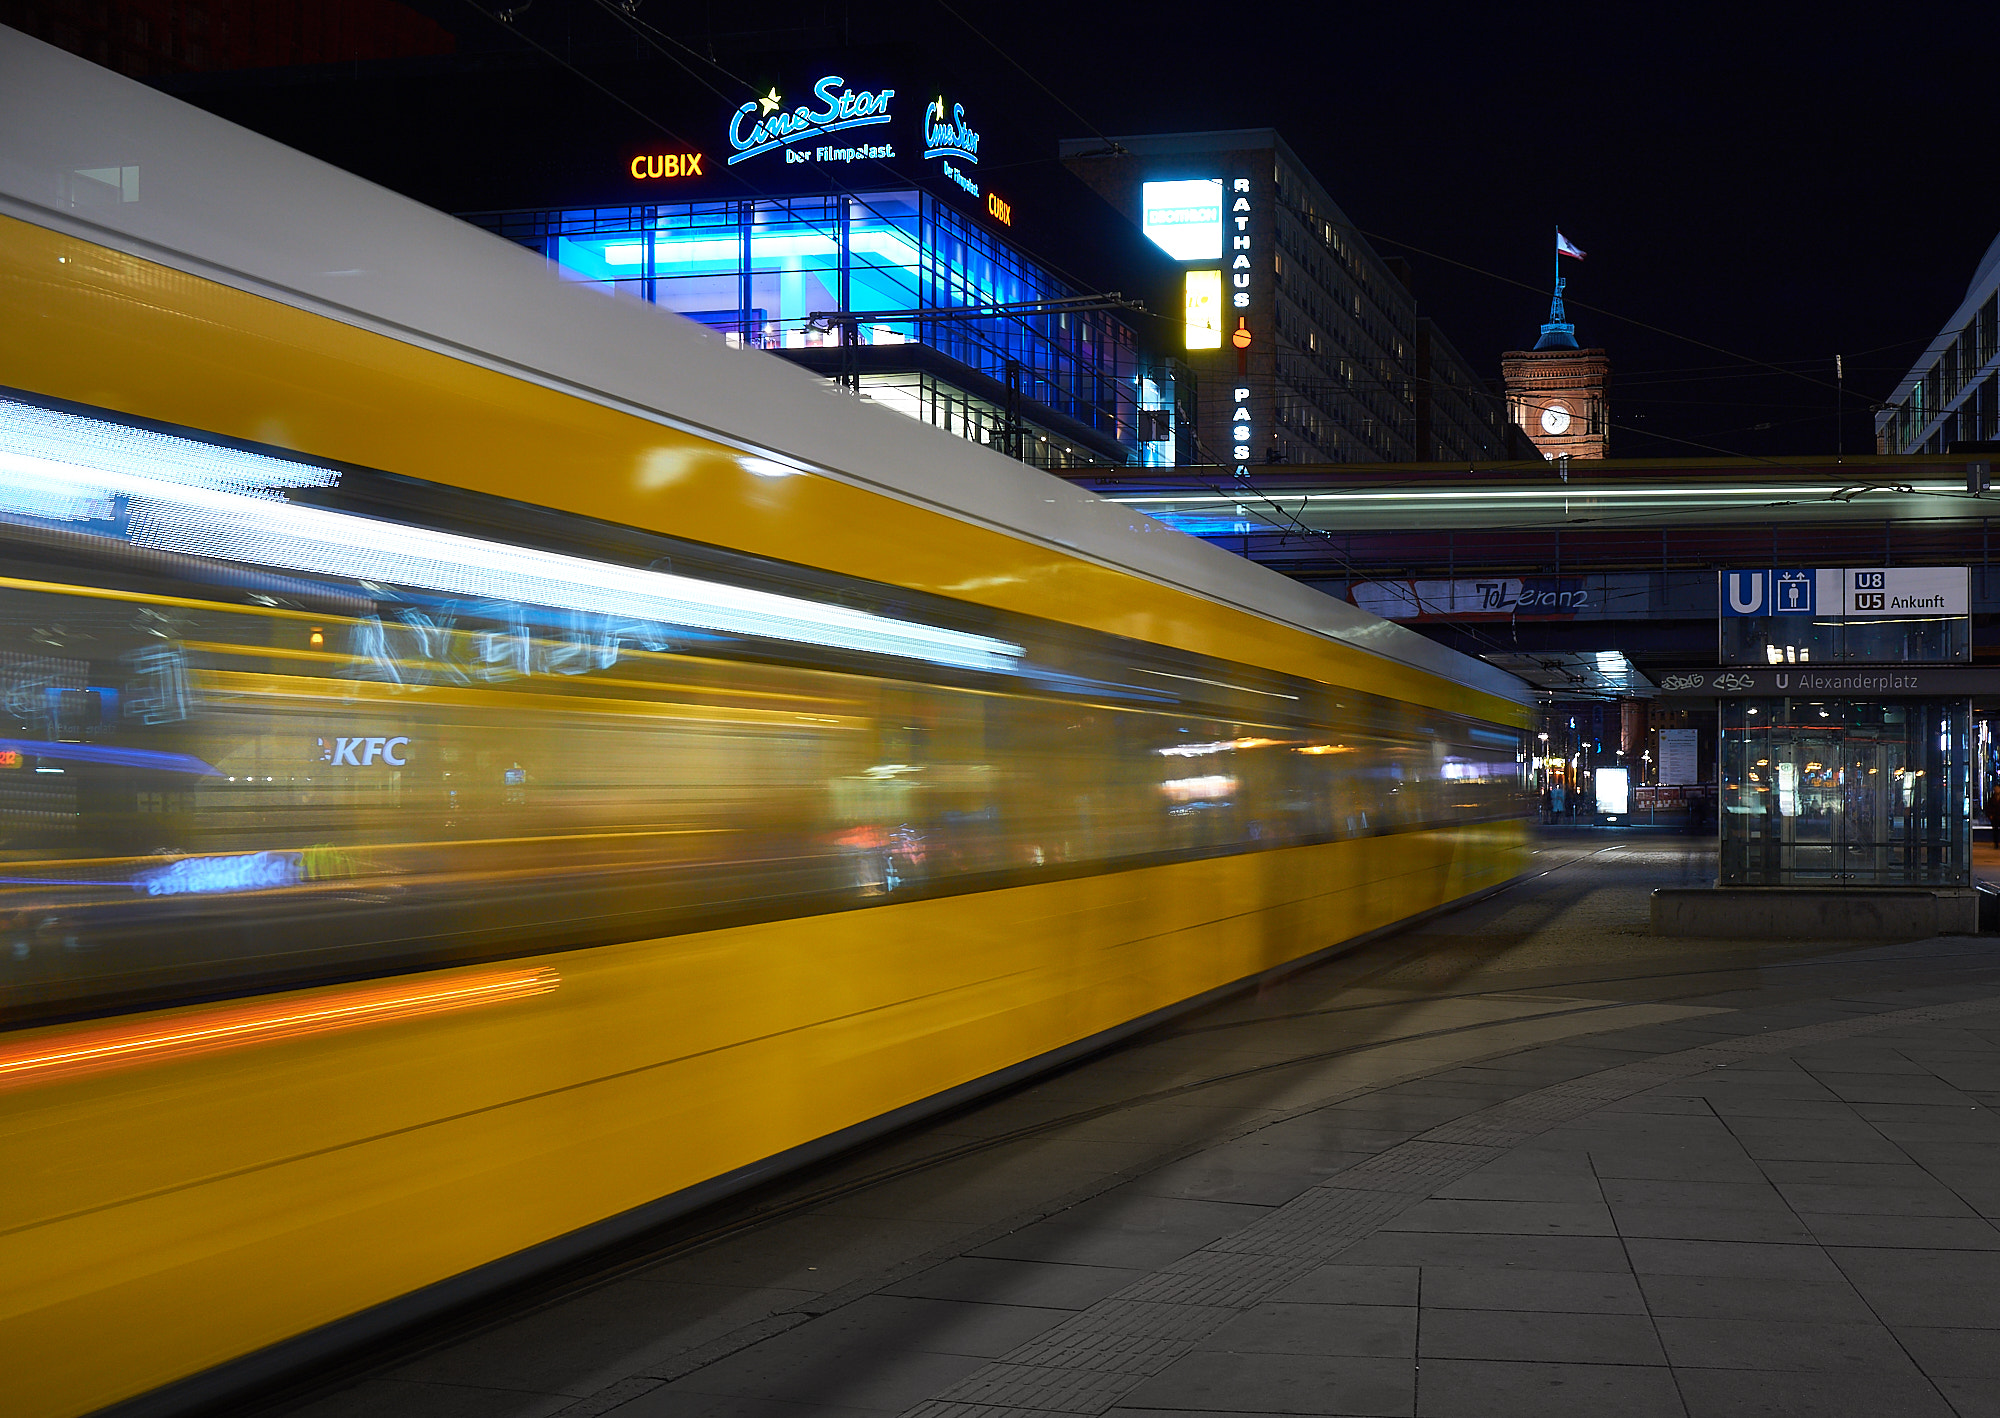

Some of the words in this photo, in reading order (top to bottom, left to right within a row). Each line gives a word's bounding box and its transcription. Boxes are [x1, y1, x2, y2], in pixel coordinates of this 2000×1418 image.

[729, 76, 895, 151] CineStar
[925, 102, 979, 153] CineStar
[631, 153, 702, 179] CUBIX
[786, 148, 811, 164] Der
[988, 192, 1011, 227] CUBIX
[1232, 178, 1251, 307] RATHAUS
[1729, 573, 1762, 613] U
[1858, 573, 1882, 587] U8
[1858, 594, 1882, 609] U5
[1891, 595, 1945, 609] Ankunft
[1776, 674, 1788, 688] U
[1799, 673, 1917, 691] Alexanderplatz
[331, 736, 408, 766] KFC
